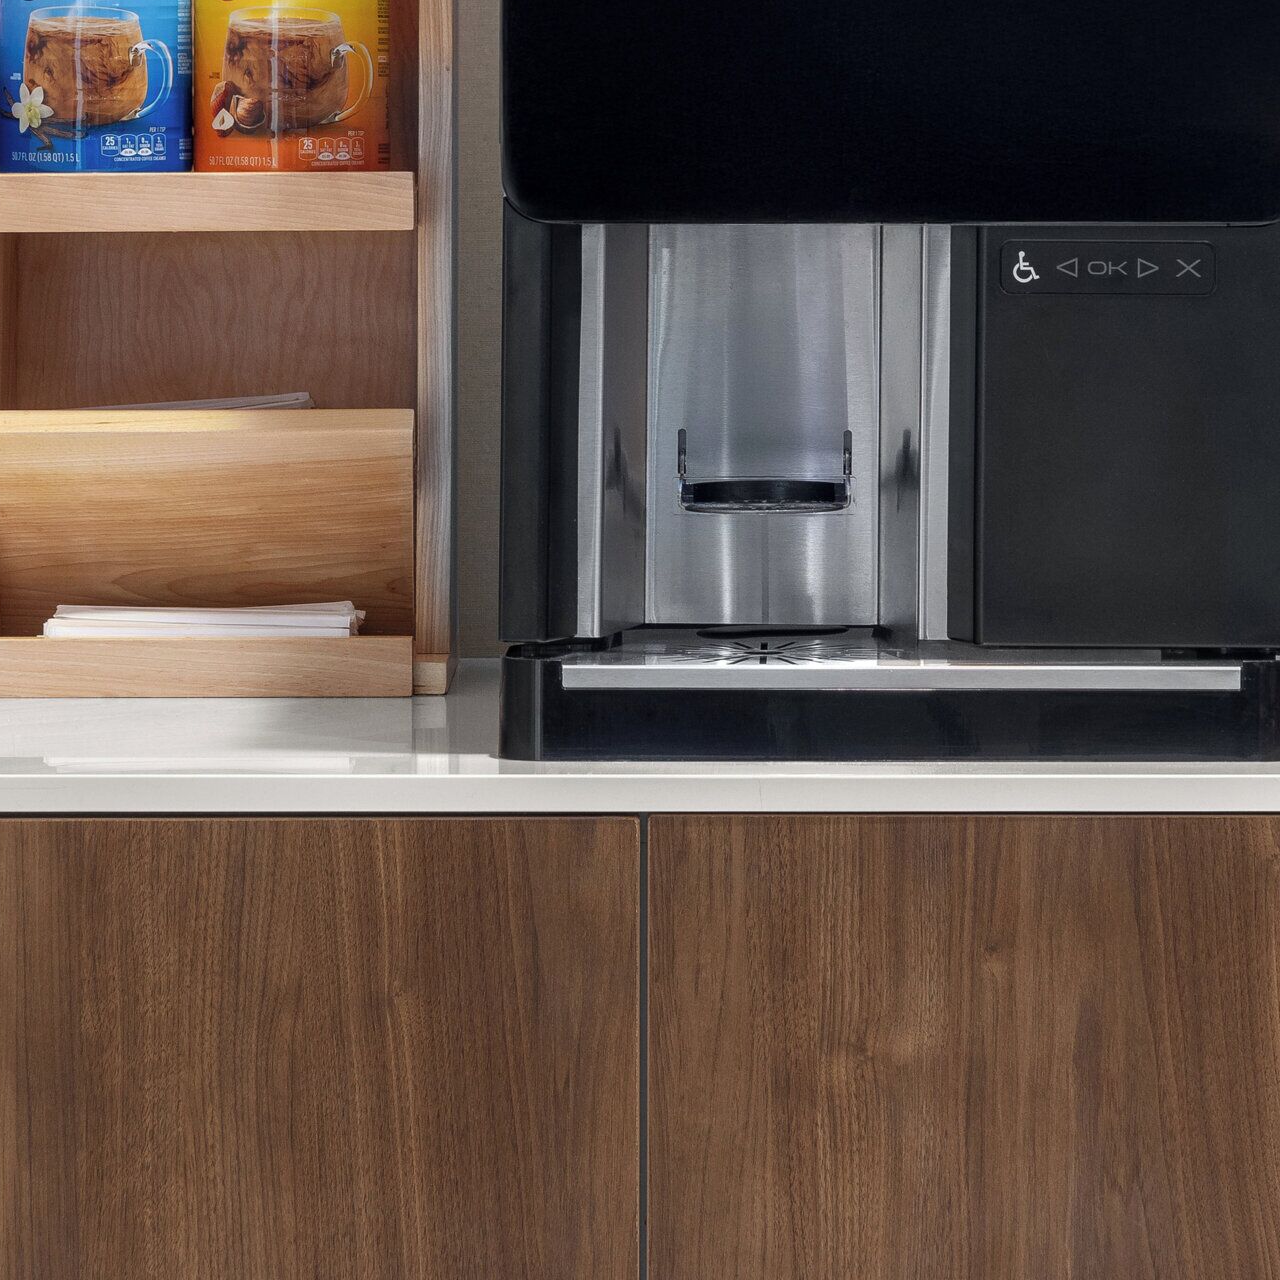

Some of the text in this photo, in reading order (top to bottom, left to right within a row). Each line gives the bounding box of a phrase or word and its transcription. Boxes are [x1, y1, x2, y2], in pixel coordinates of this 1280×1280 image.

[105, 136, 115, 146] 25
[303, 139, 312, 149] 25
[21, 152, 28, 161] FL
[28, 152, 36, 162] OZ
[37, 152, 51, 162] (1.58
[52, 152, 64, 163] QT)
[65, 152, 74, 162] 1.5
[219, 156, 225, 166] FL
[226, 156, 234, 166] OZ
[234, 155, 249, 166] (1.58
[249, 156, 261, 167] QT)
[262, 156, 272, 166] 1.5
[1087, 261, 1128, 276] OK
